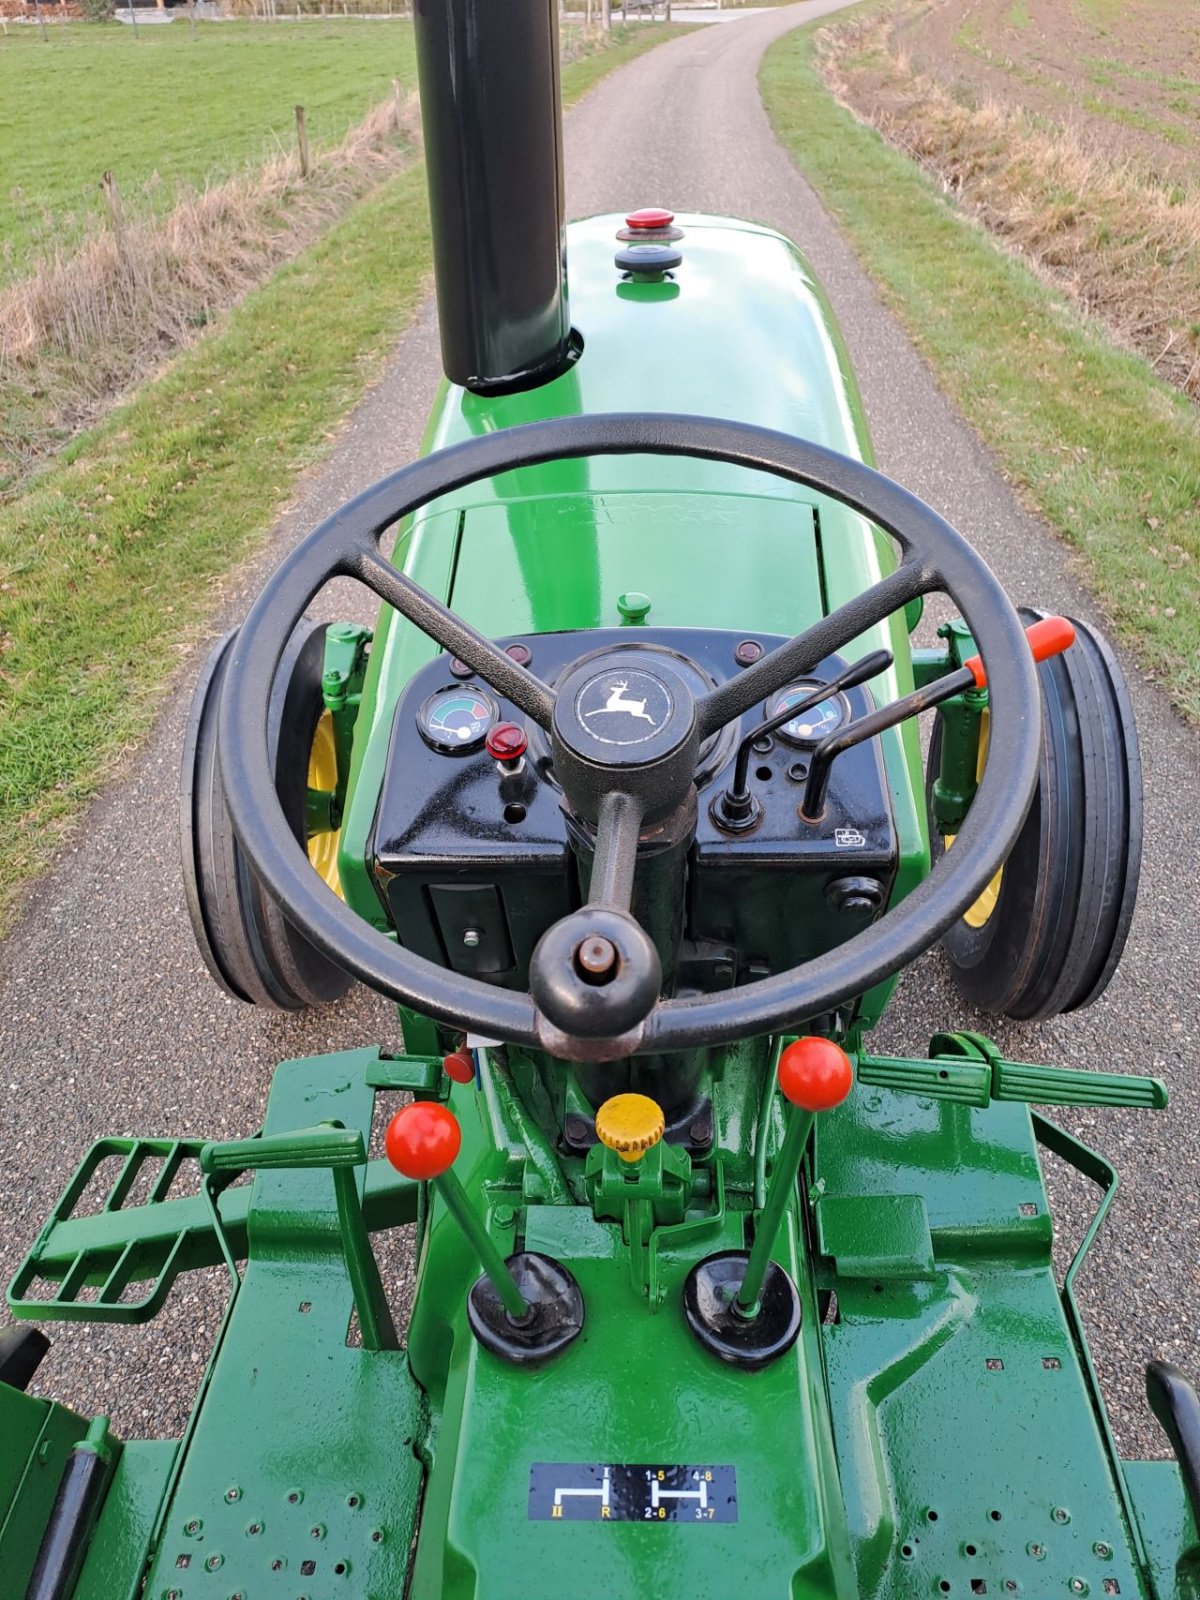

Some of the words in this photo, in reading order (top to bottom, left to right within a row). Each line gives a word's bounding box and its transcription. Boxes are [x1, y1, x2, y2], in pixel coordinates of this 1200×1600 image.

[645, 1470, 665, 1481] 1-5
[692, 1470, 712, 1481] 4-8
[601, 1506, 611, 1517] R
[645, 1507, 666, 1518] 2-6
[695, 1508, 715, 1519] 3-7
